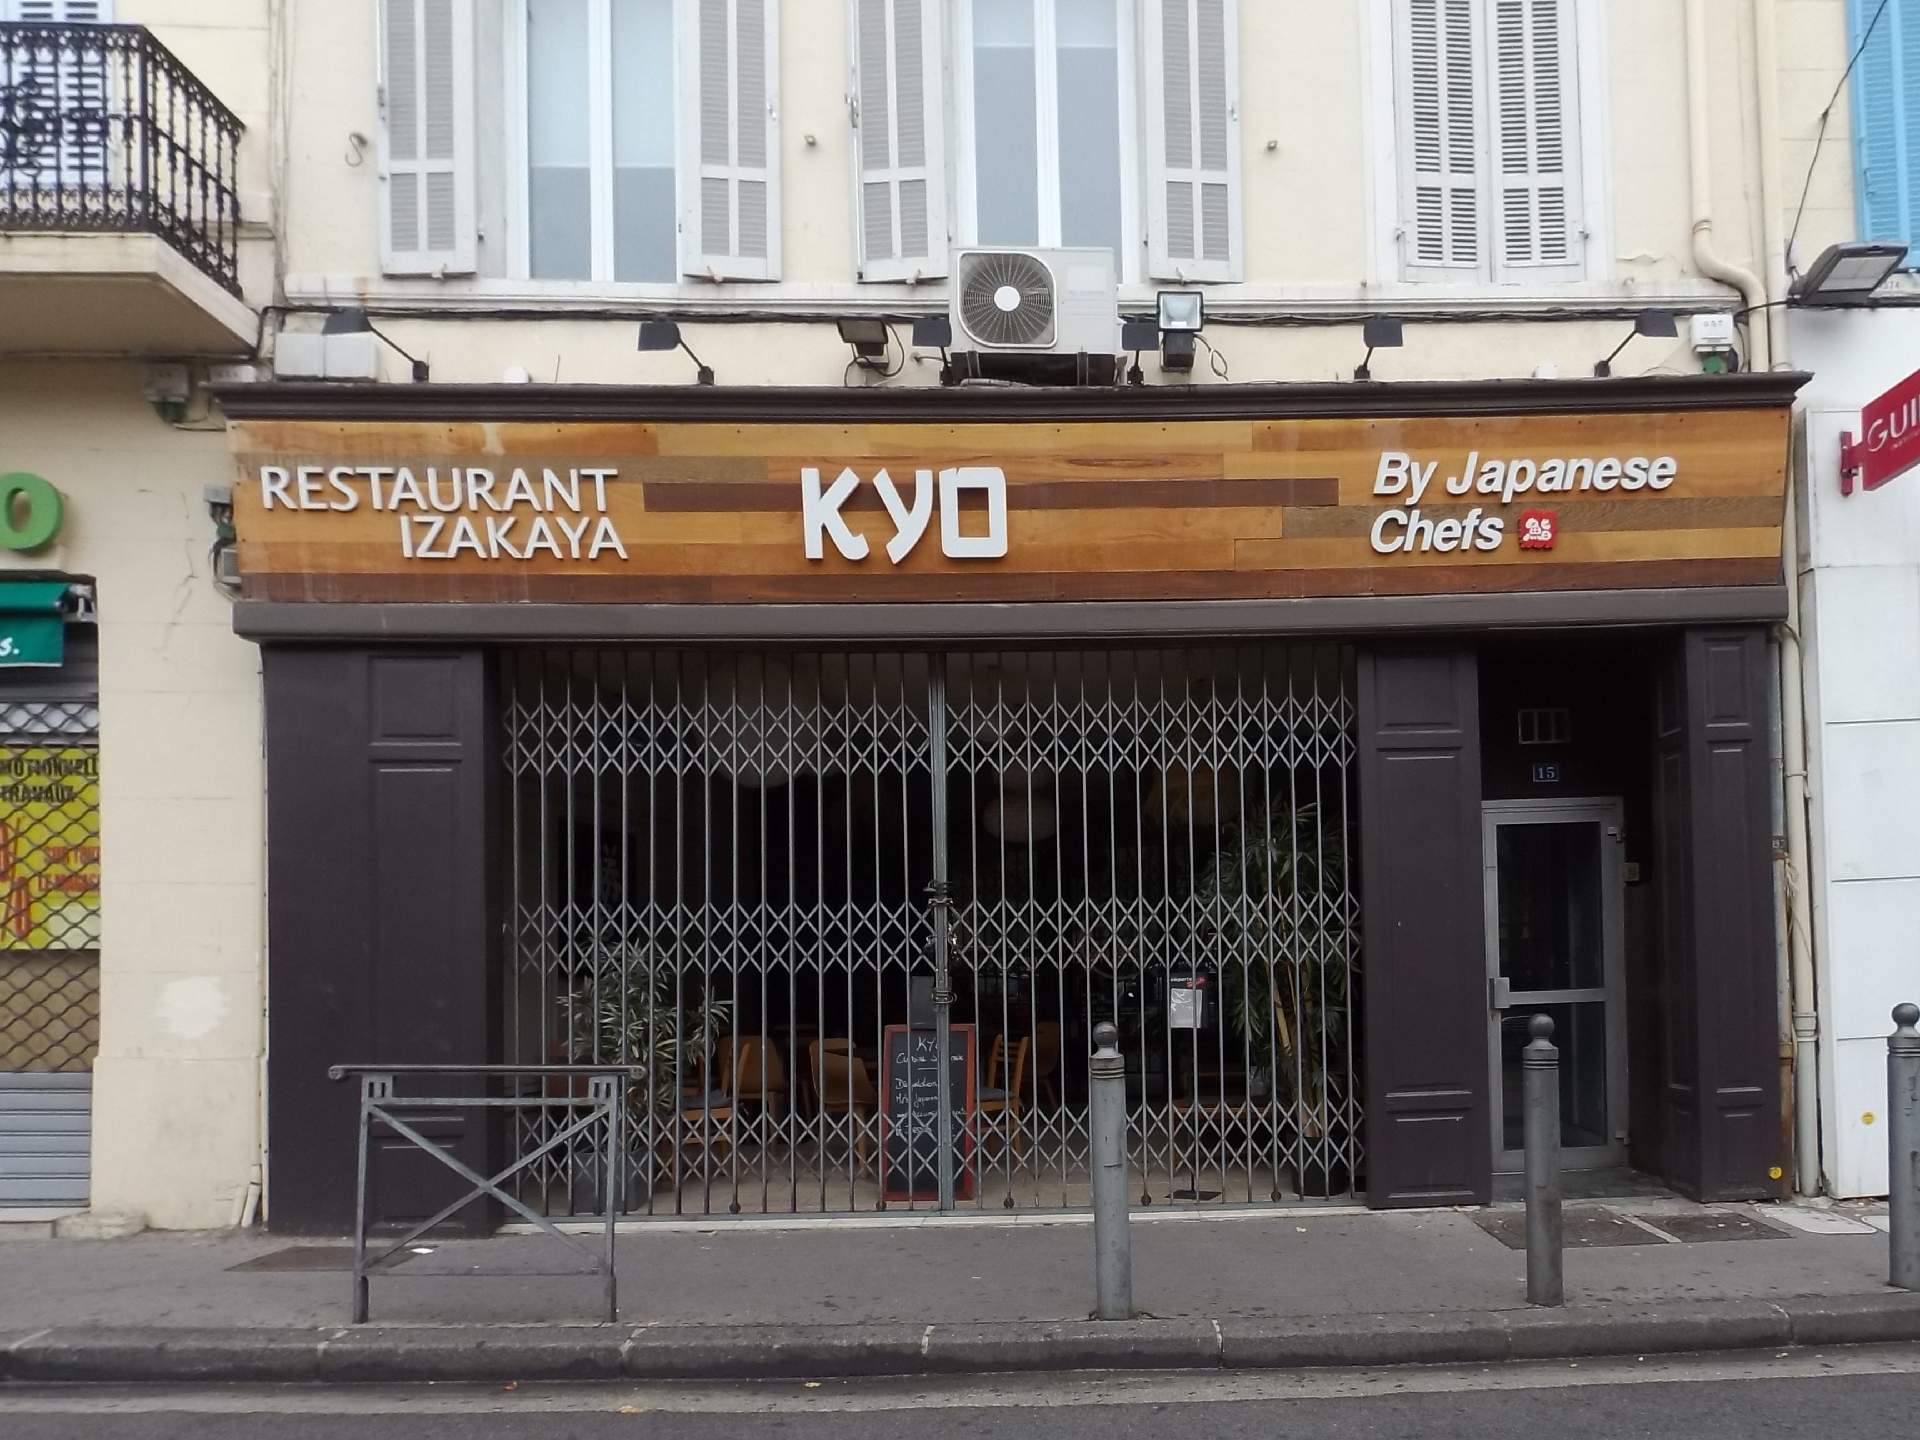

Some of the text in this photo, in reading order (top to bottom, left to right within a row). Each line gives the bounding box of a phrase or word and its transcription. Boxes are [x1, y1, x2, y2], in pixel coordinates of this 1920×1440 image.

[1867, 394, 1920, 452] GUI
[259, 466, 619, 512] RESTAURANT
[1373, 451, 1677, 506] By Japanese
[400, 514, 629, 560] IZAKAYA
[1370, 507, 1505, 553] Chefs
[1538, 766, 1556, 779] 15
